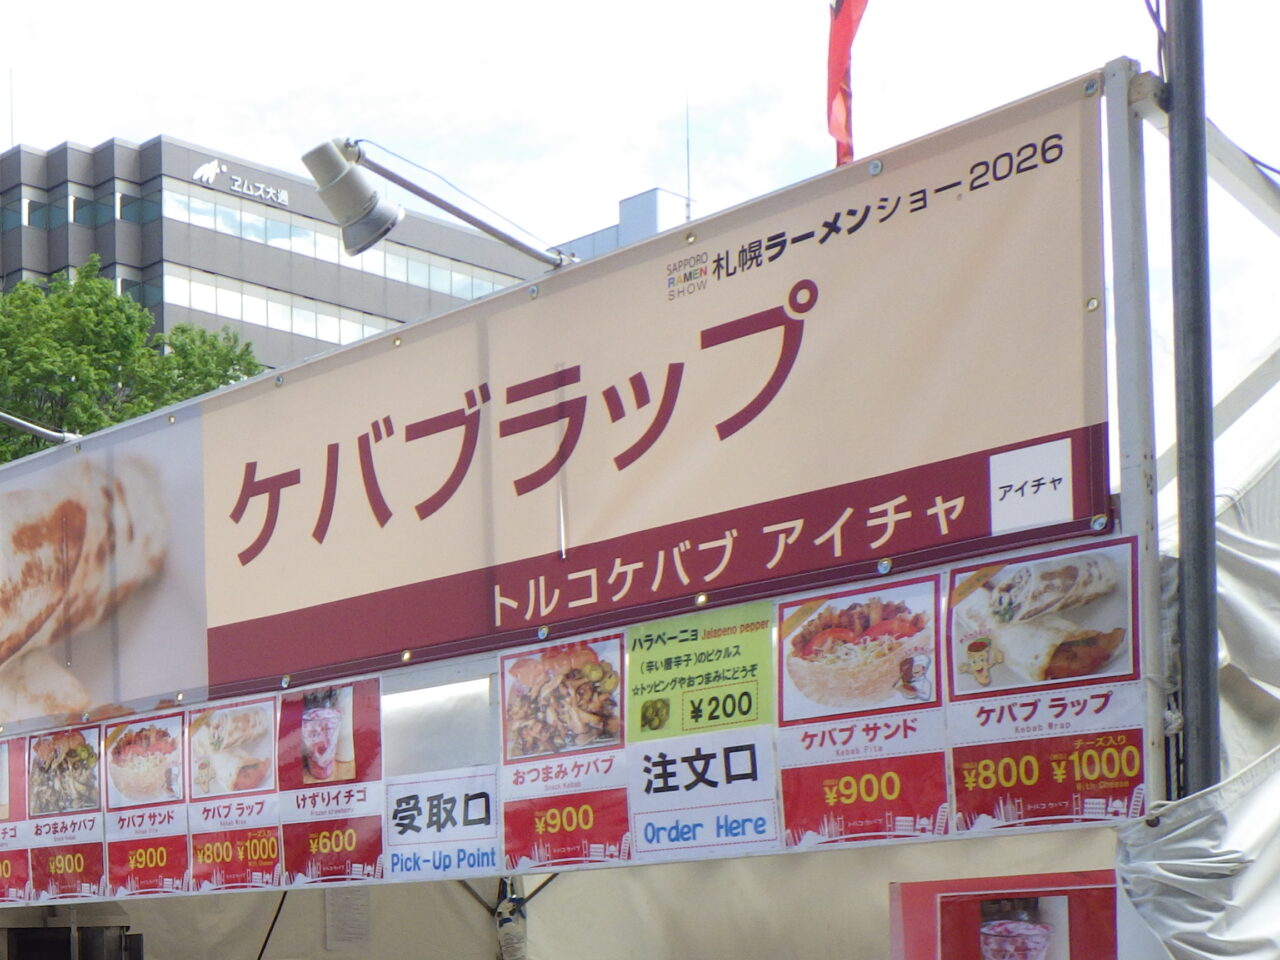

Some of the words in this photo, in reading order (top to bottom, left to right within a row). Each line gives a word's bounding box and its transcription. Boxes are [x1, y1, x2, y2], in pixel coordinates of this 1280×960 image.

[667, 251, 709, 276] SAPPORO
[667, 265, 708, 288] RAMEN
[668, 279, 708, 301] SHOW
[228, 278, 819, 567] ケバブラップ
[997, 476, 1064, 503] アイチャ
[763, 488, 968, 559] アイチャ
[739, 619, 770, 635] pepper
[690, 691, 753, 723] ¥200
[976, 698, 1041, 727] ケバブ
[1048, 690, 1114, 719] ラップ
[801, 724, 857, 751] ケバブ
[862, 717, 918, 743] サンド
[643, 743, 759, 795] 注文口
[963, 755, 1040, 791] ¥800
[1051, 745, 1140, 783] ¥1000
[296, 787, 368, 810] けずりイチゴ
[824, 771, 901, 807] ¥900
[118, 813, 144, 830] ケバブ
[148, 809, 175, 826] サンド
[202, 803, 231, 821] ケバブ
[235, 800, 266, 817] ラップ
[392, 791, 491, 836] 受取口
[535, 804, 594, 835] ¥900
[309, 828, 357, 854] ¥600
[643, 819, 704, 844] Order
[716, 814, 767, 838] Here
[129, 847, 167, 870] ¥900
[197, 841, 233, 864] ¥800
[237, 837, 278, 861] ¥1000
[391, 850, 452, 873] Pick-Up
[457, 847, 496, 869] Point
[49, 853, 85, 875] ¥900
